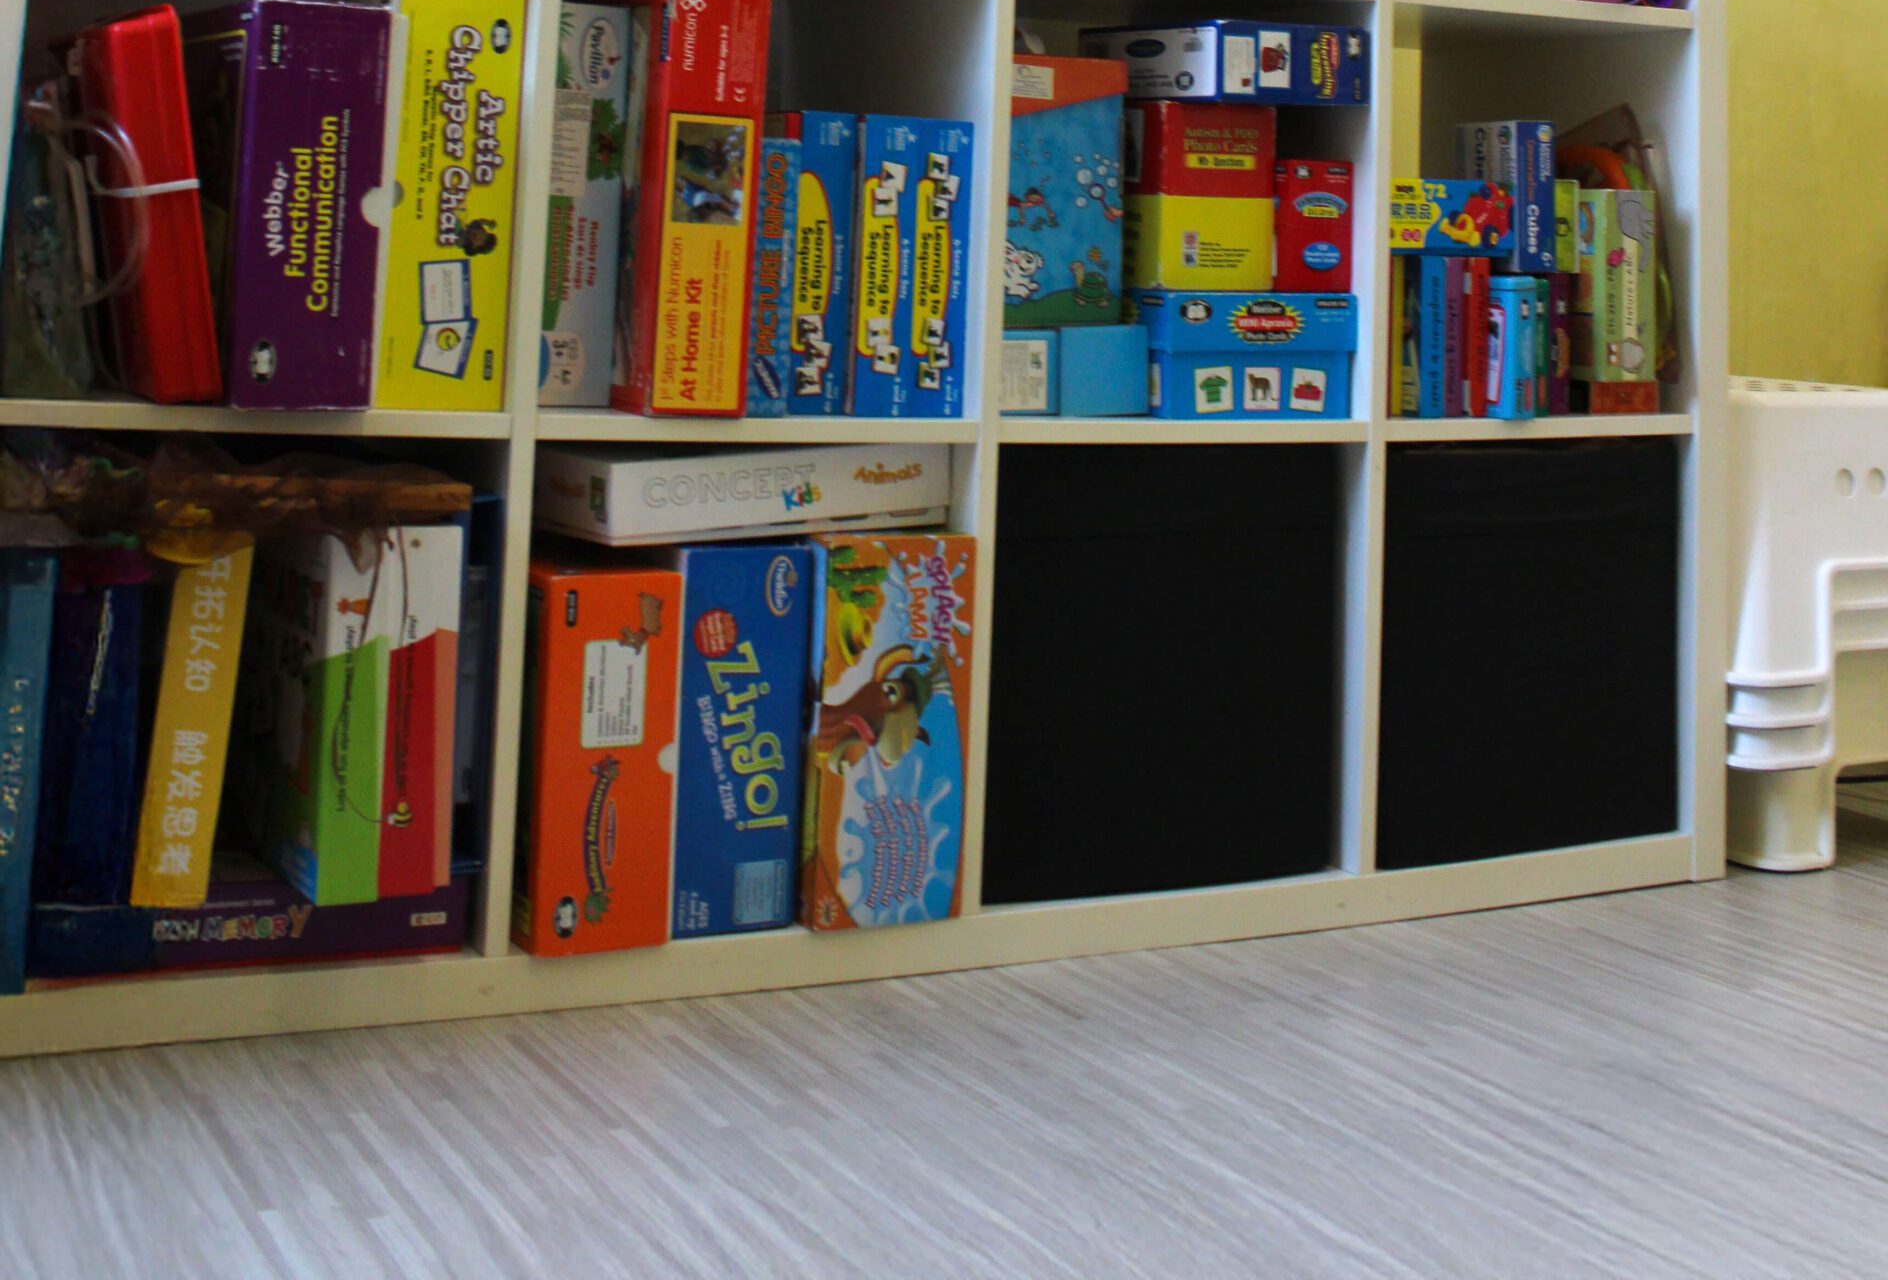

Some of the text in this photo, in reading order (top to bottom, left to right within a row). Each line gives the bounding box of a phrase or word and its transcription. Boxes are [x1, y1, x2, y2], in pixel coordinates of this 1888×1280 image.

[588, 25, 607, 85] Pavilion
[682, 12, 699, 71] numicon
[437, 24, 482, 247] Chipper Chat
[475, 90, 506, 184] Artic
[1184, 138, 1259, 154] Photo Cards
[1475, 127, 1487, 179] Cube
[284, 147, 313, 278] Functional
[306, 115, 339, 313] Communication
[763, 151, 788, 240] BINGO
[1527, 204, 1540, 254] Cubes
[586, 266, 598, 288] Flip
[666, 236, 683, 304] Numicon
[798, 225, 815, 303] Sequence
[808, 219, 828, 311] Learning to
[865, 231, 881, 307] Sequence
[874, 223, 894, 315] Learning to
[916, 231, 933, 307] Sequence
[928, 224, 946, 315] Learning to
[664, 309, 679, 339] with
[680, 278, 704, 401] At Home Kit
[755, 249, 782, 357] PICTURE
[660, 343, 678, 384] Steps
[643, 464, 816, 508] CONCEPT
[782, 481, 823, 511] Kids
[852, 462, 923, 485] Animals
[904, 570, 930, 642] LAMA
[695, 694, 720, 744] BINGO
[709, 746, 724, 773] with
[717, 782, 738, 820] ZING
[705, 640, 789, 832] Zingo!
[202, 903, 313, 942] MEMORY
